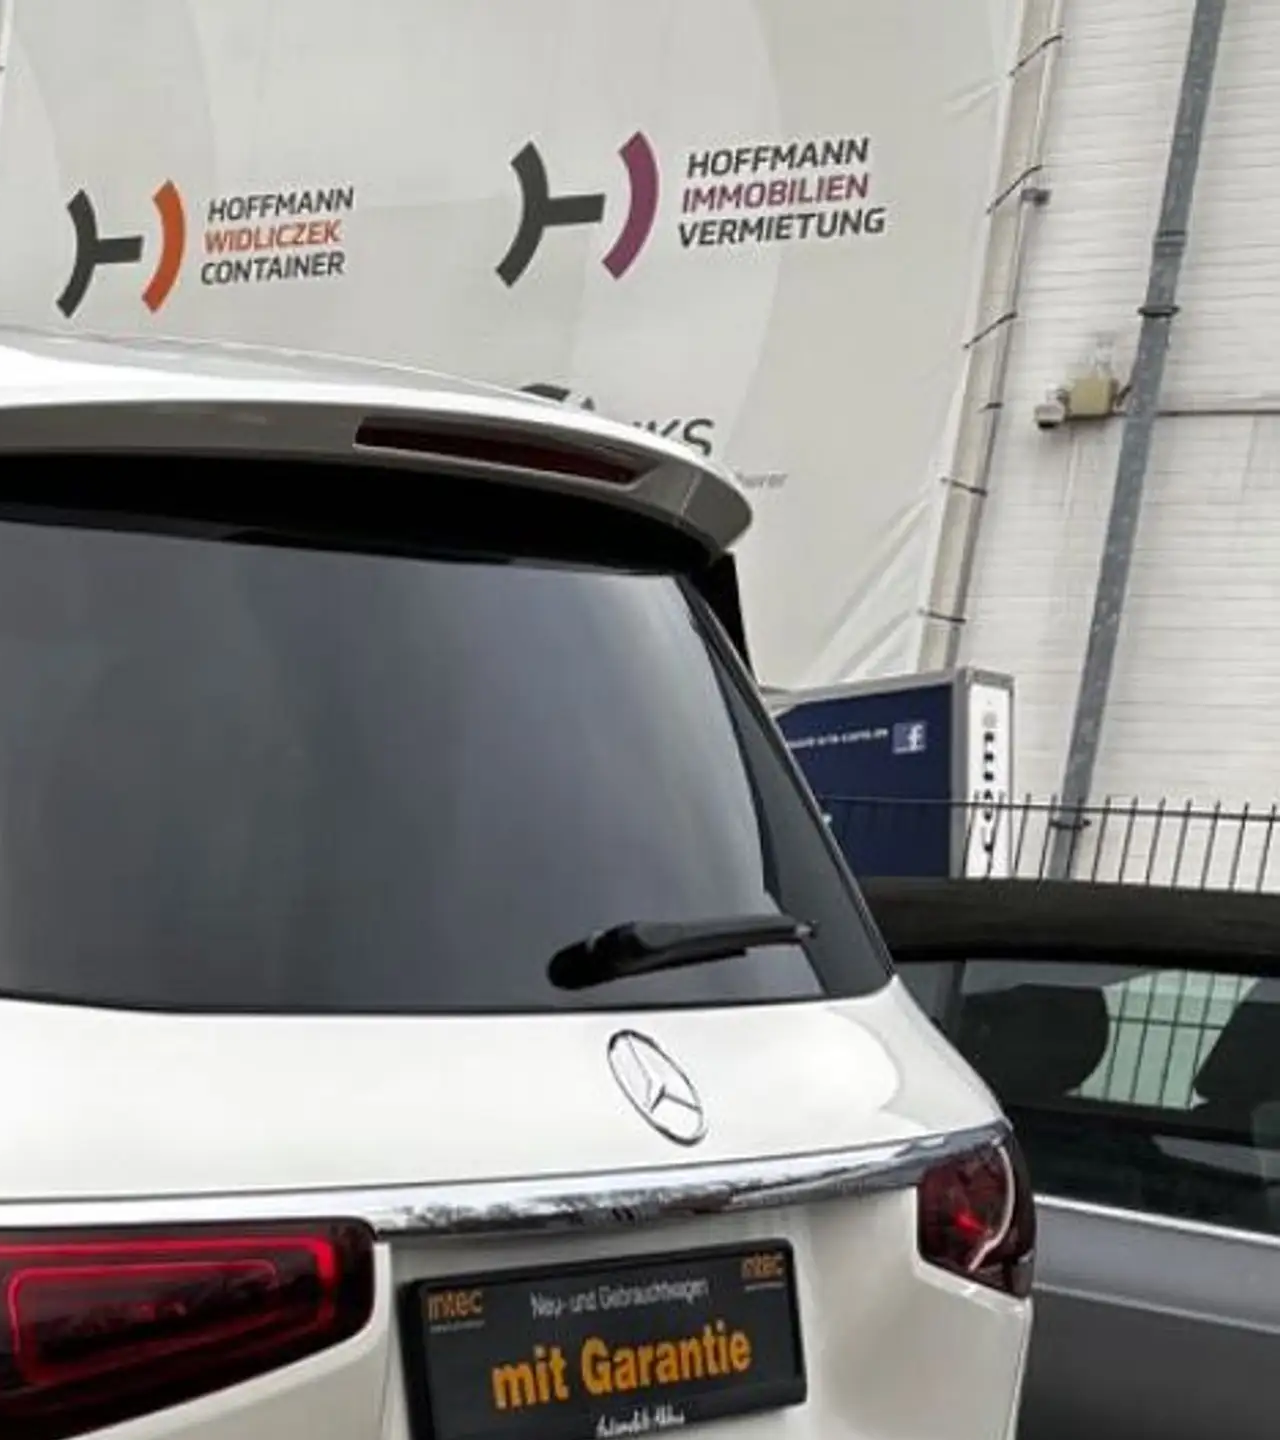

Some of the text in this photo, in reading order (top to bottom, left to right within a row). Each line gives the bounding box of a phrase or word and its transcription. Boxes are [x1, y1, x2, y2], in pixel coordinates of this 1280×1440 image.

[687, 137, 869, 178] HOFFMANN
[207, 186, 354, 223] HOFFMANN
[682, 173, 869, 214] IMMOBILIEN
[204, 219, 342, 255] WIDLICZEK
[678, 207, 886, 249] VERMIETUNG
[200, 251, 346, 286] CONTAINER
[492, 1320, 751, 1409] mit Garantie
